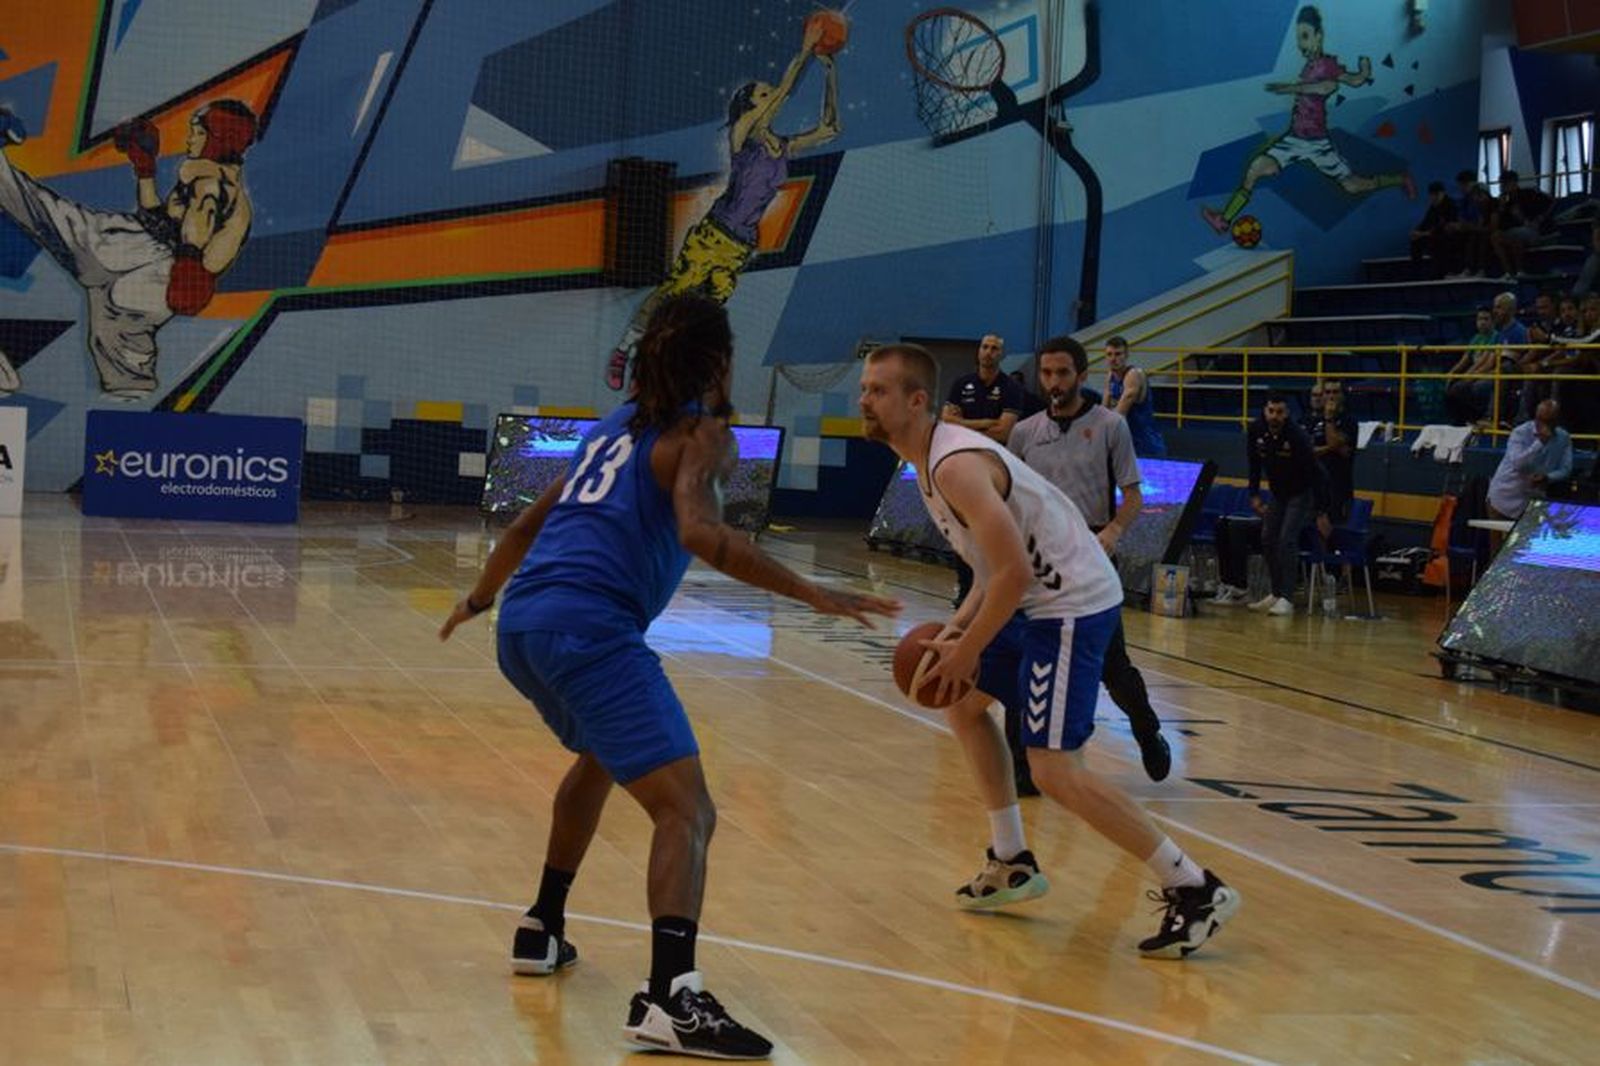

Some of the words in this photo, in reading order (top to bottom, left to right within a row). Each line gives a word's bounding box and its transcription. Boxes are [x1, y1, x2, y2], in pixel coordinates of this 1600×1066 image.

[120, 448, 288, 483] euronics
[559, 433, 633, 504] 13
[160, 482, 277, 498] electrodomésticos
